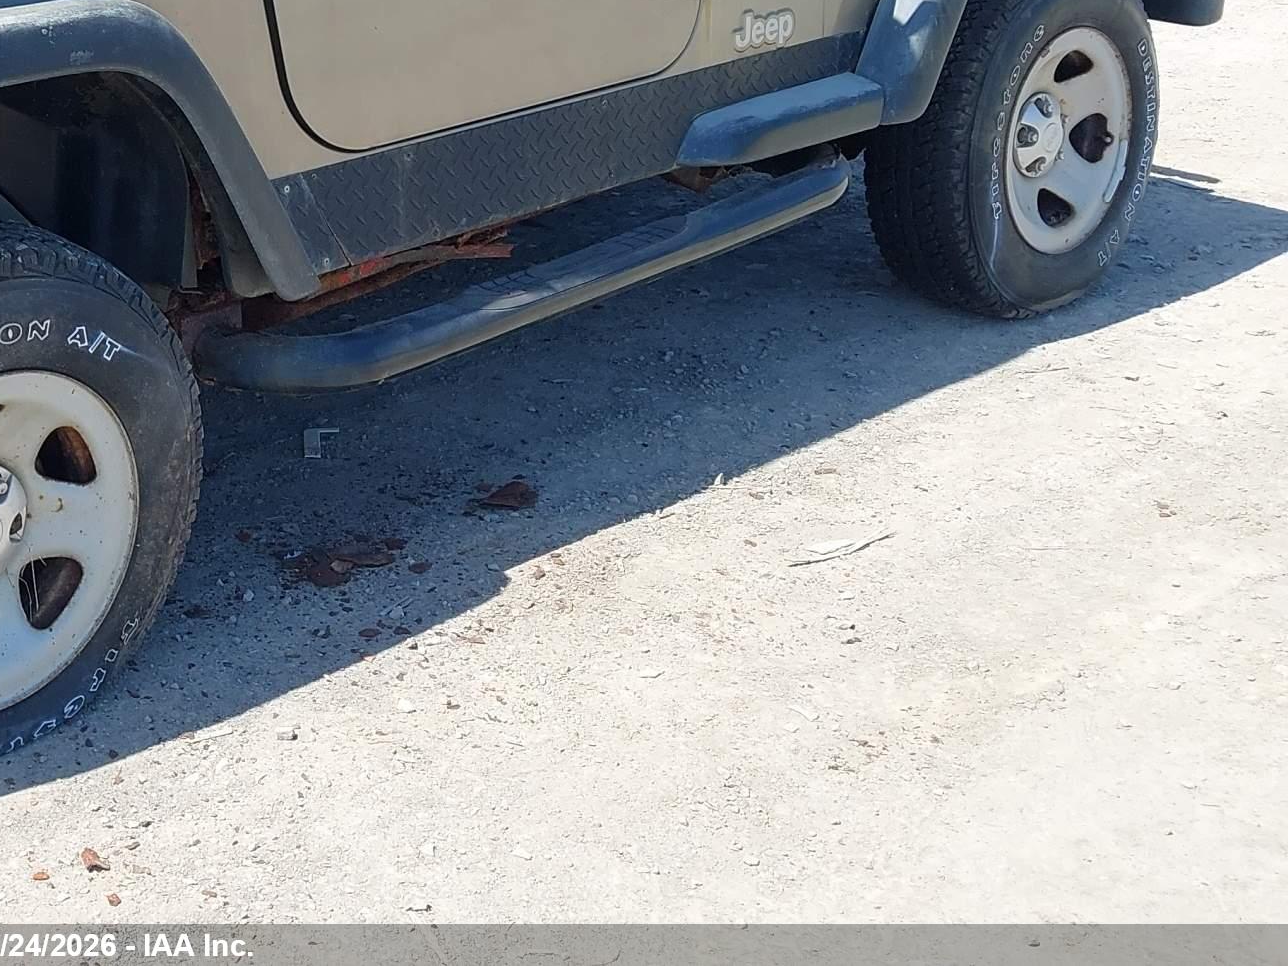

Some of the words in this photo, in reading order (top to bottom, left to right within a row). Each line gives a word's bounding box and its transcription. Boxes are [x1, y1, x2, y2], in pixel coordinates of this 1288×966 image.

[734, 9, 794, 51] Jeep
[1123, 38, 1157, 222] DESTINATION
[1096, 229, 1121, 267] A/T
[67, 325, 122, 362] A/T
